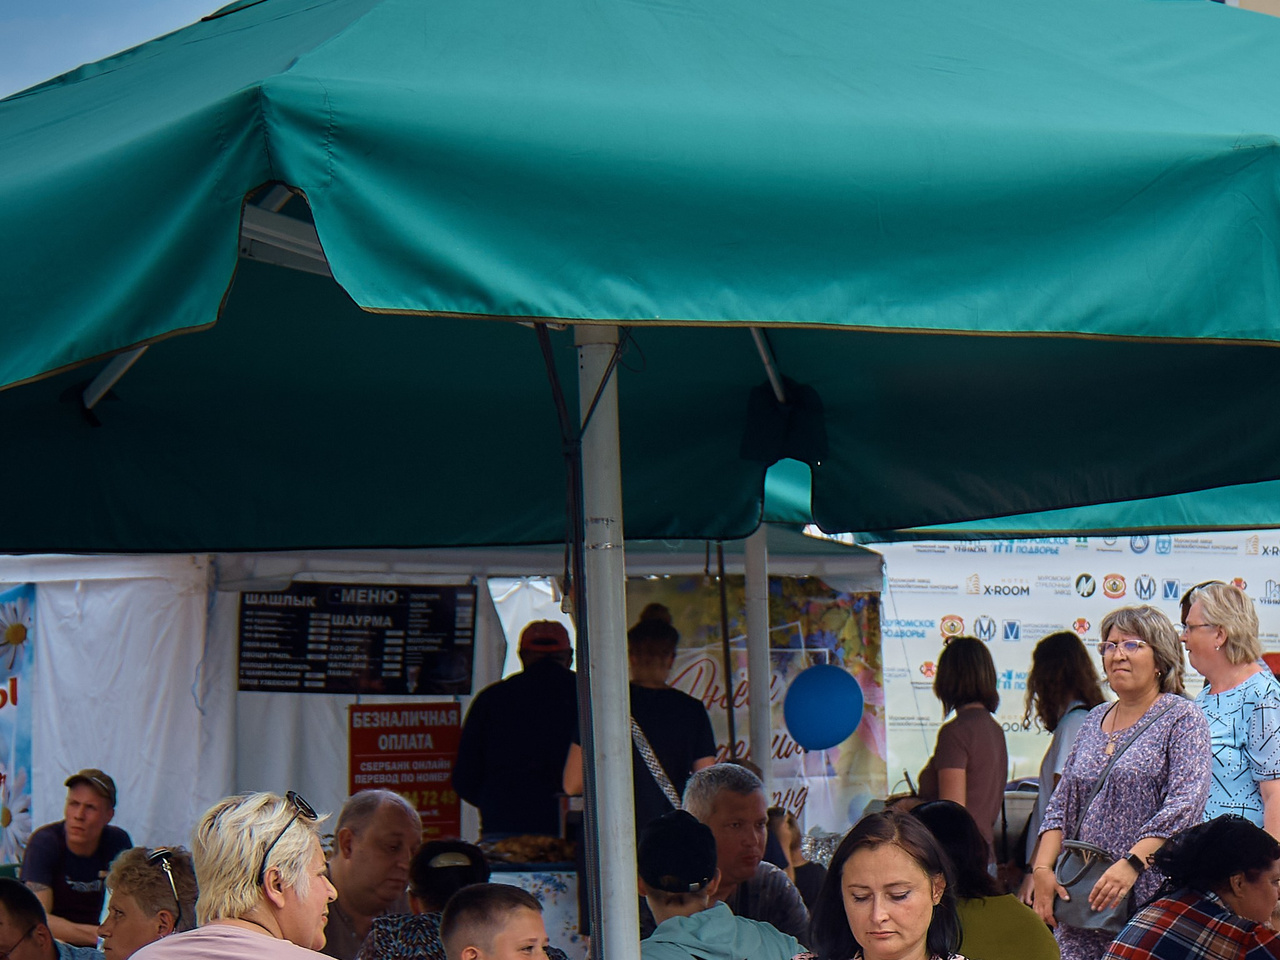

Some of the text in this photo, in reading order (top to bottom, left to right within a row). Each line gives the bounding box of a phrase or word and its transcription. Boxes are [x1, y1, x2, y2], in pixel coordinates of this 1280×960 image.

[1016, 545, 1060, 555] ПОДВОРЬЕ
[245, 593, 318, 608] ШАШЛЫК
[340, 589, 399, 605] МЕНЮ
[331, 614, 393, 628] ШАУРМА
[352, 710, 459, 729] БЕЗНАЛИЧНАЯ
[378, 733, 434, 751] ОПЛАТА
[360, 757, 452, 772] СБЕРБАНК ОНЛАЙН
[354, 772, 452, 785] ПЕРЕВОД ПО НОМЕР
